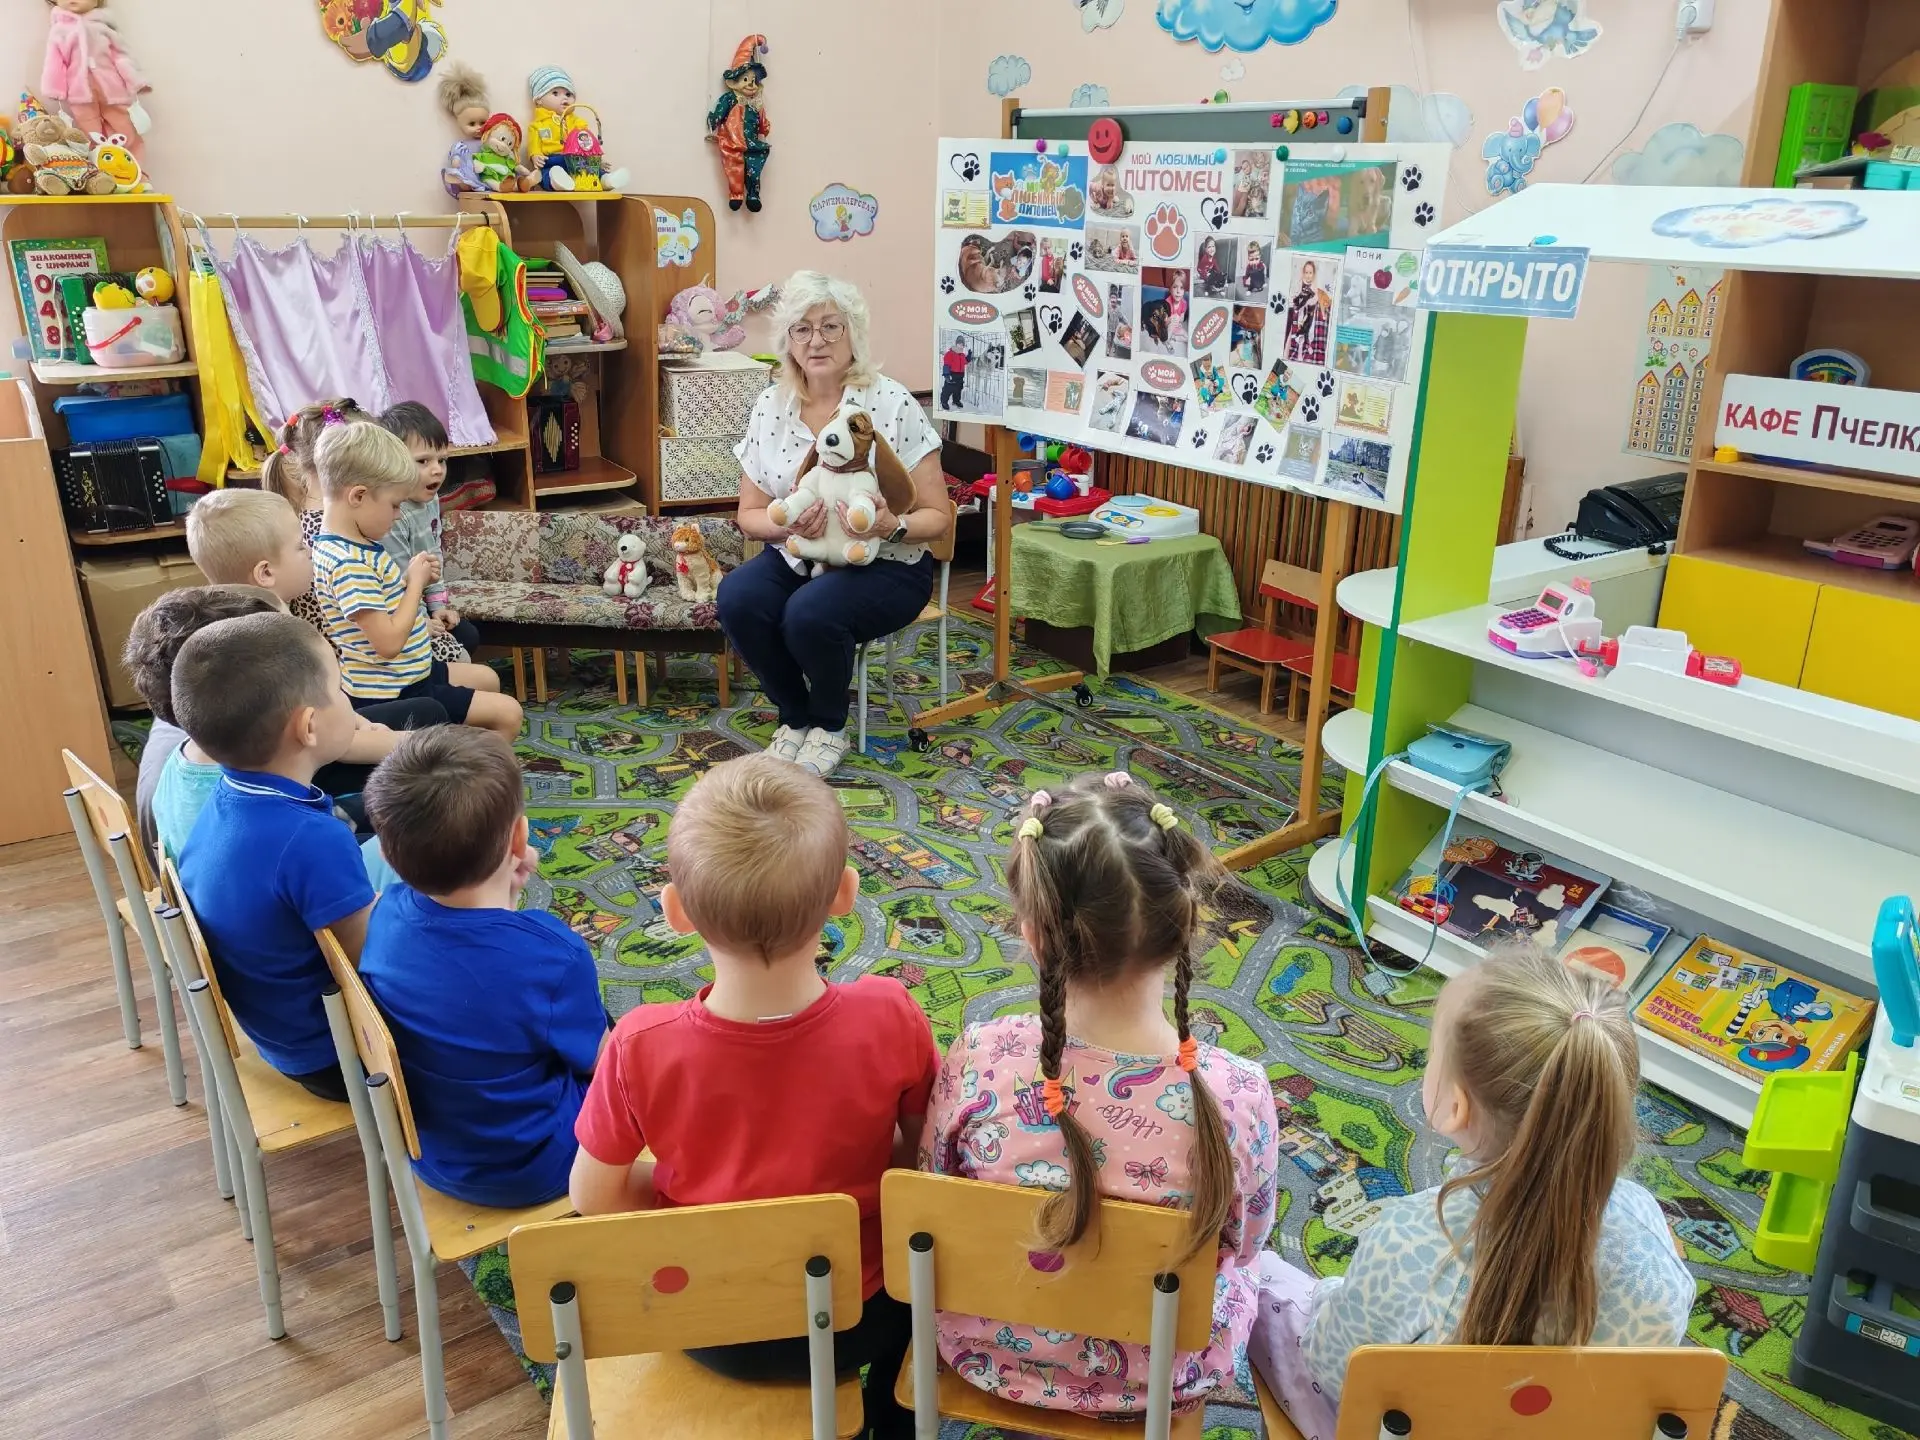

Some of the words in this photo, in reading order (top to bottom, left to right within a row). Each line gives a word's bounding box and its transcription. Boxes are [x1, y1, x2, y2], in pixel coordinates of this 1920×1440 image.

[1132, 154, 1151, 164] МОЙ
[1155, 153, 1216, 166] ЛЮБИМЫЙ
[1124, 169, 1222, 194] ПИТОМЕЦ
[1018, 203, 1057, 217] ПИТОМЕЦ
[30, 253, 92, 262] ЗНАКОМИМСЯ
[1356, 250, 1382, 260] ПОНИ
[46, 261, 90, 269] ЦИФРАМИ
[1425, 258, 1577, 302] ОТКРЫТО
[40, 300, 56, 319] 4
[967, 305, 988, 313] МОЙ
[47, 325, 60, 345] 8
[1157, 369, 1176, 377] МОЙ
[1724, 403, 1802, 436] КАФЕ
[1811, 404, 1920, 453] ПЧЕЛК
[1653, 996, 1703, 1024] ЗНАКИ
[1645, 1004, 1727, 1047] ДОРОЖНЫЕ
[1097, 1104, 1165, 1139] Hello
